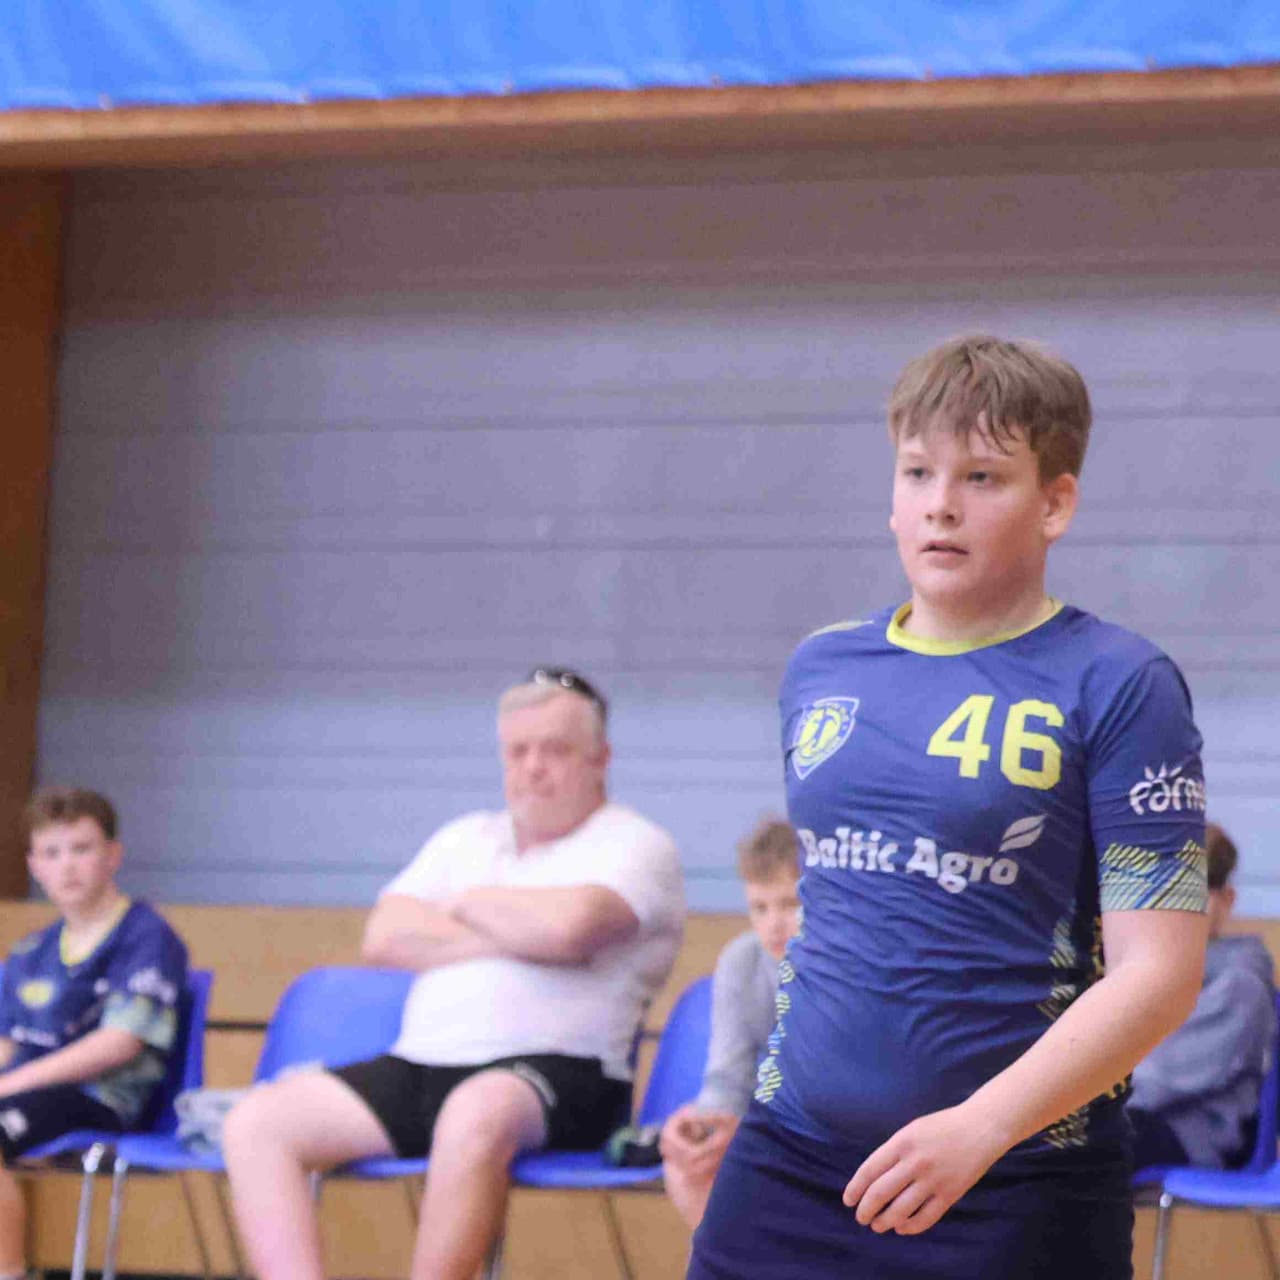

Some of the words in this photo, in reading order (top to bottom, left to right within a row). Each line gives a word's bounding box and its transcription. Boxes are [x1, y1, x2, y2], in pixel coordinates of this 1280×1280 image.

[926, 694, 1065, 791] 46
[796, 826, 899, 874] Baltic
[905, 837, 1020, 894] Agro
